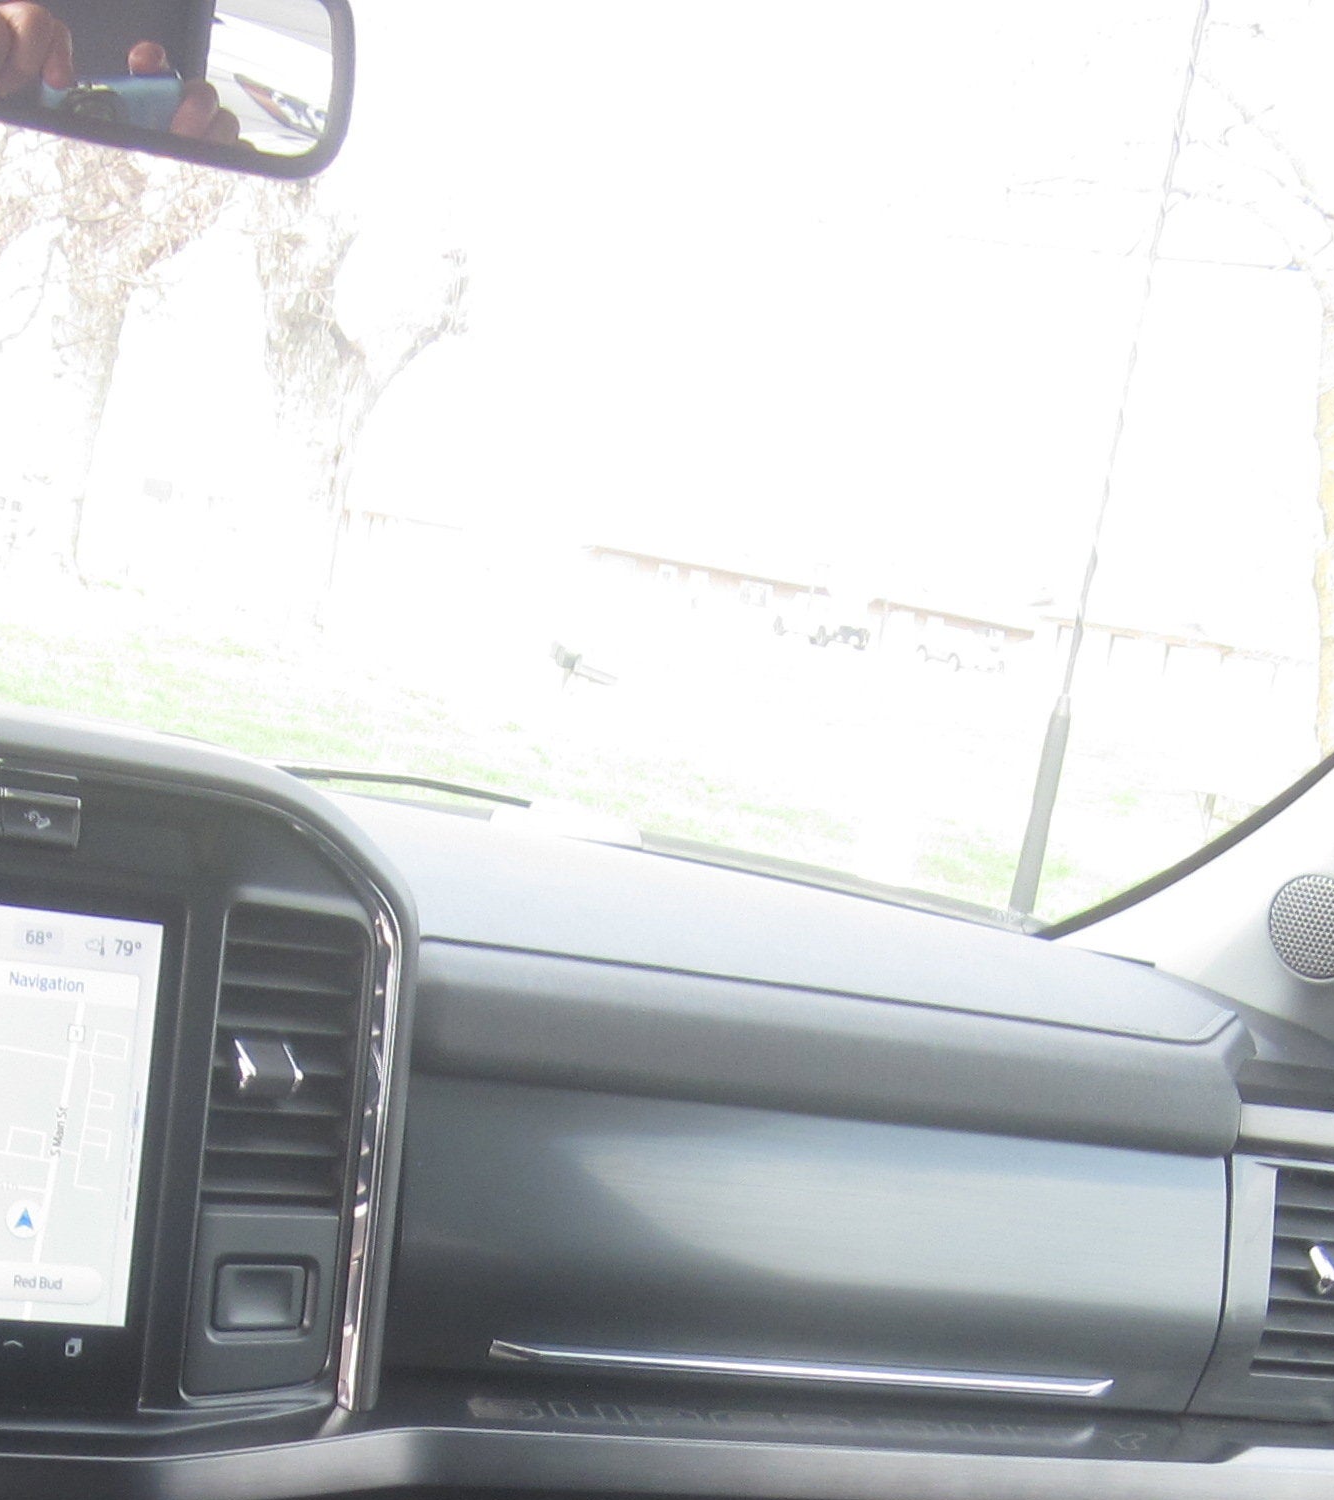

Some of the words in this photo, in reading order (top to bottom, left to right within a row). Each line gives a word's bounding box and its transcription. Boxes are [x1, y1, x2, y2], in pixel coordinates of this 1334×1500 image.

[25, 929, 54, 947] 68°
[114, 938, 142, 957] 79°
[8, 970, 85, 994] Navigation
[52, 1118, 67, 1148] Main
[13, 1273, 36, 1289] Red
[38, 1275, 63, 1291] Bud
